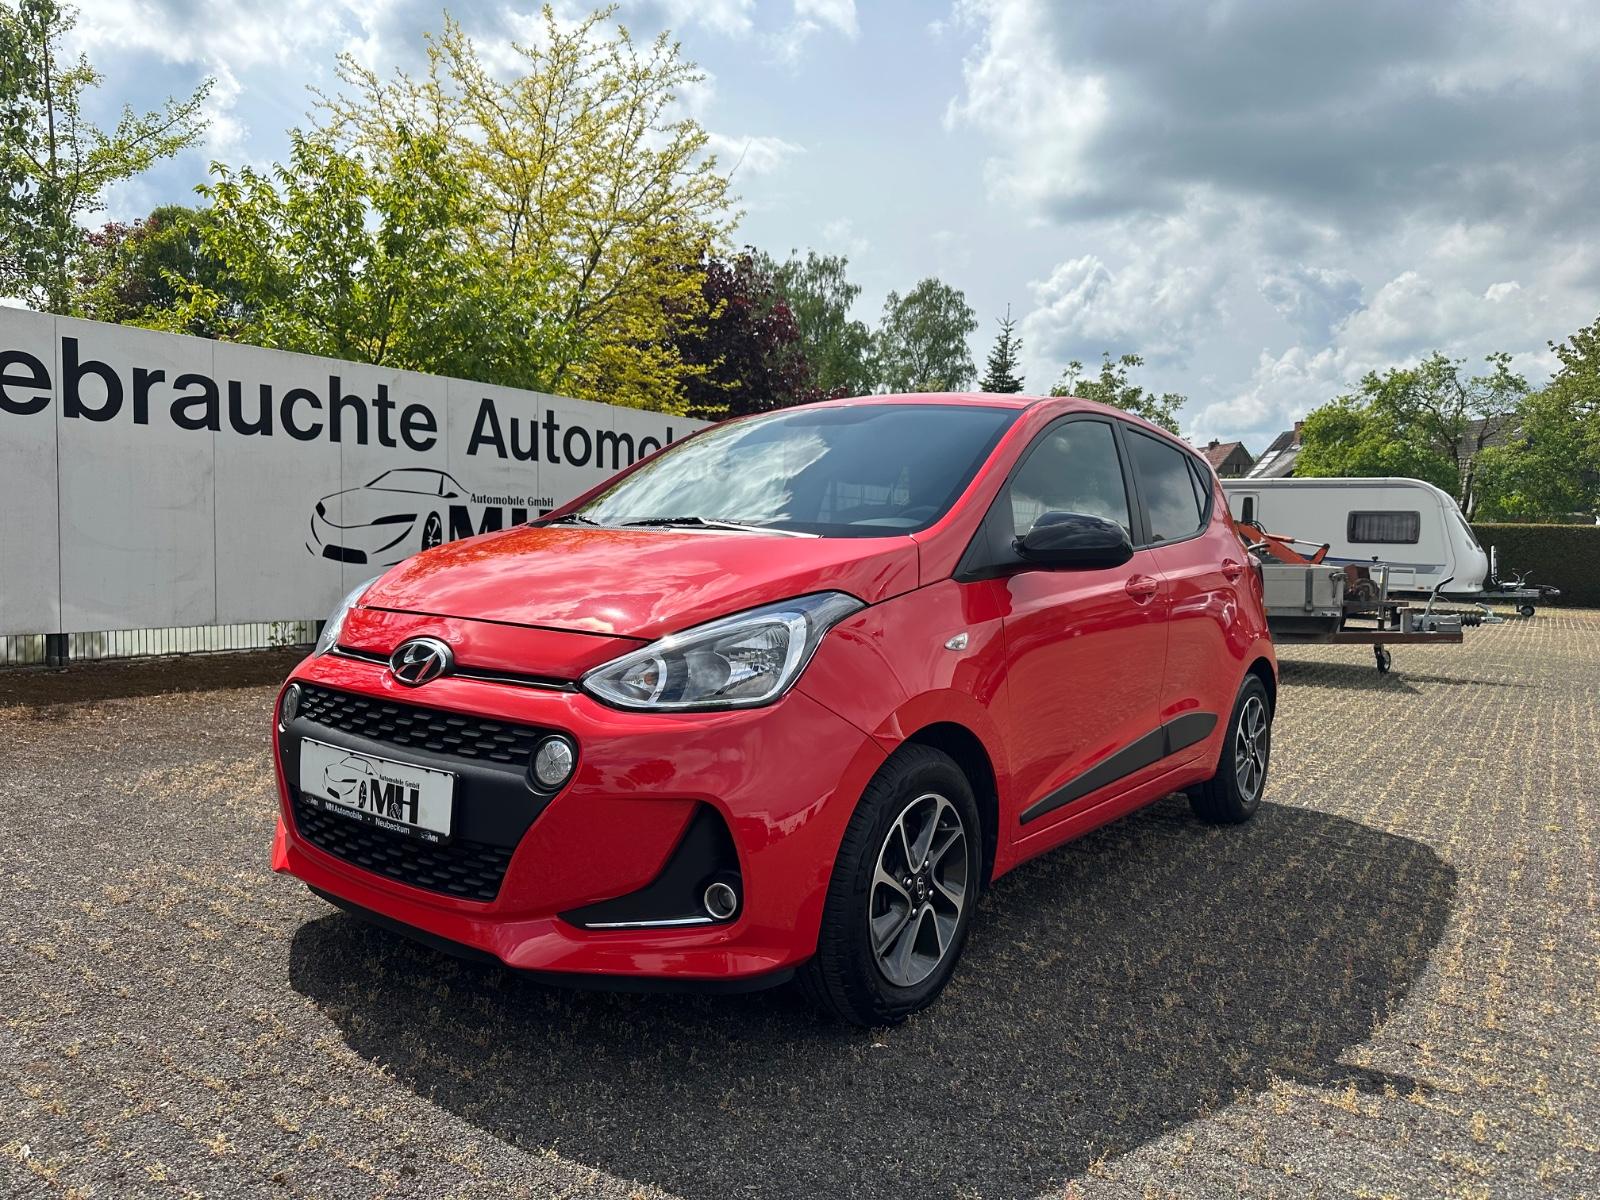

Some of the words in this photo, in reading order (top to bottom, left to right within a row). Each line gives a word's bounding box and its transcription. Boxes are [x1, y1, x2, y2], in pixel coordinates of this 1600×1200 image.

[0, 337, 437, 452] ebrauchte
[470, 493, 524, 506] Automobile
[527, 496, 554, 507] GmbH
[370, 778, 419, 825] M&H
[375, 817, 410, 834] Neubeckum
